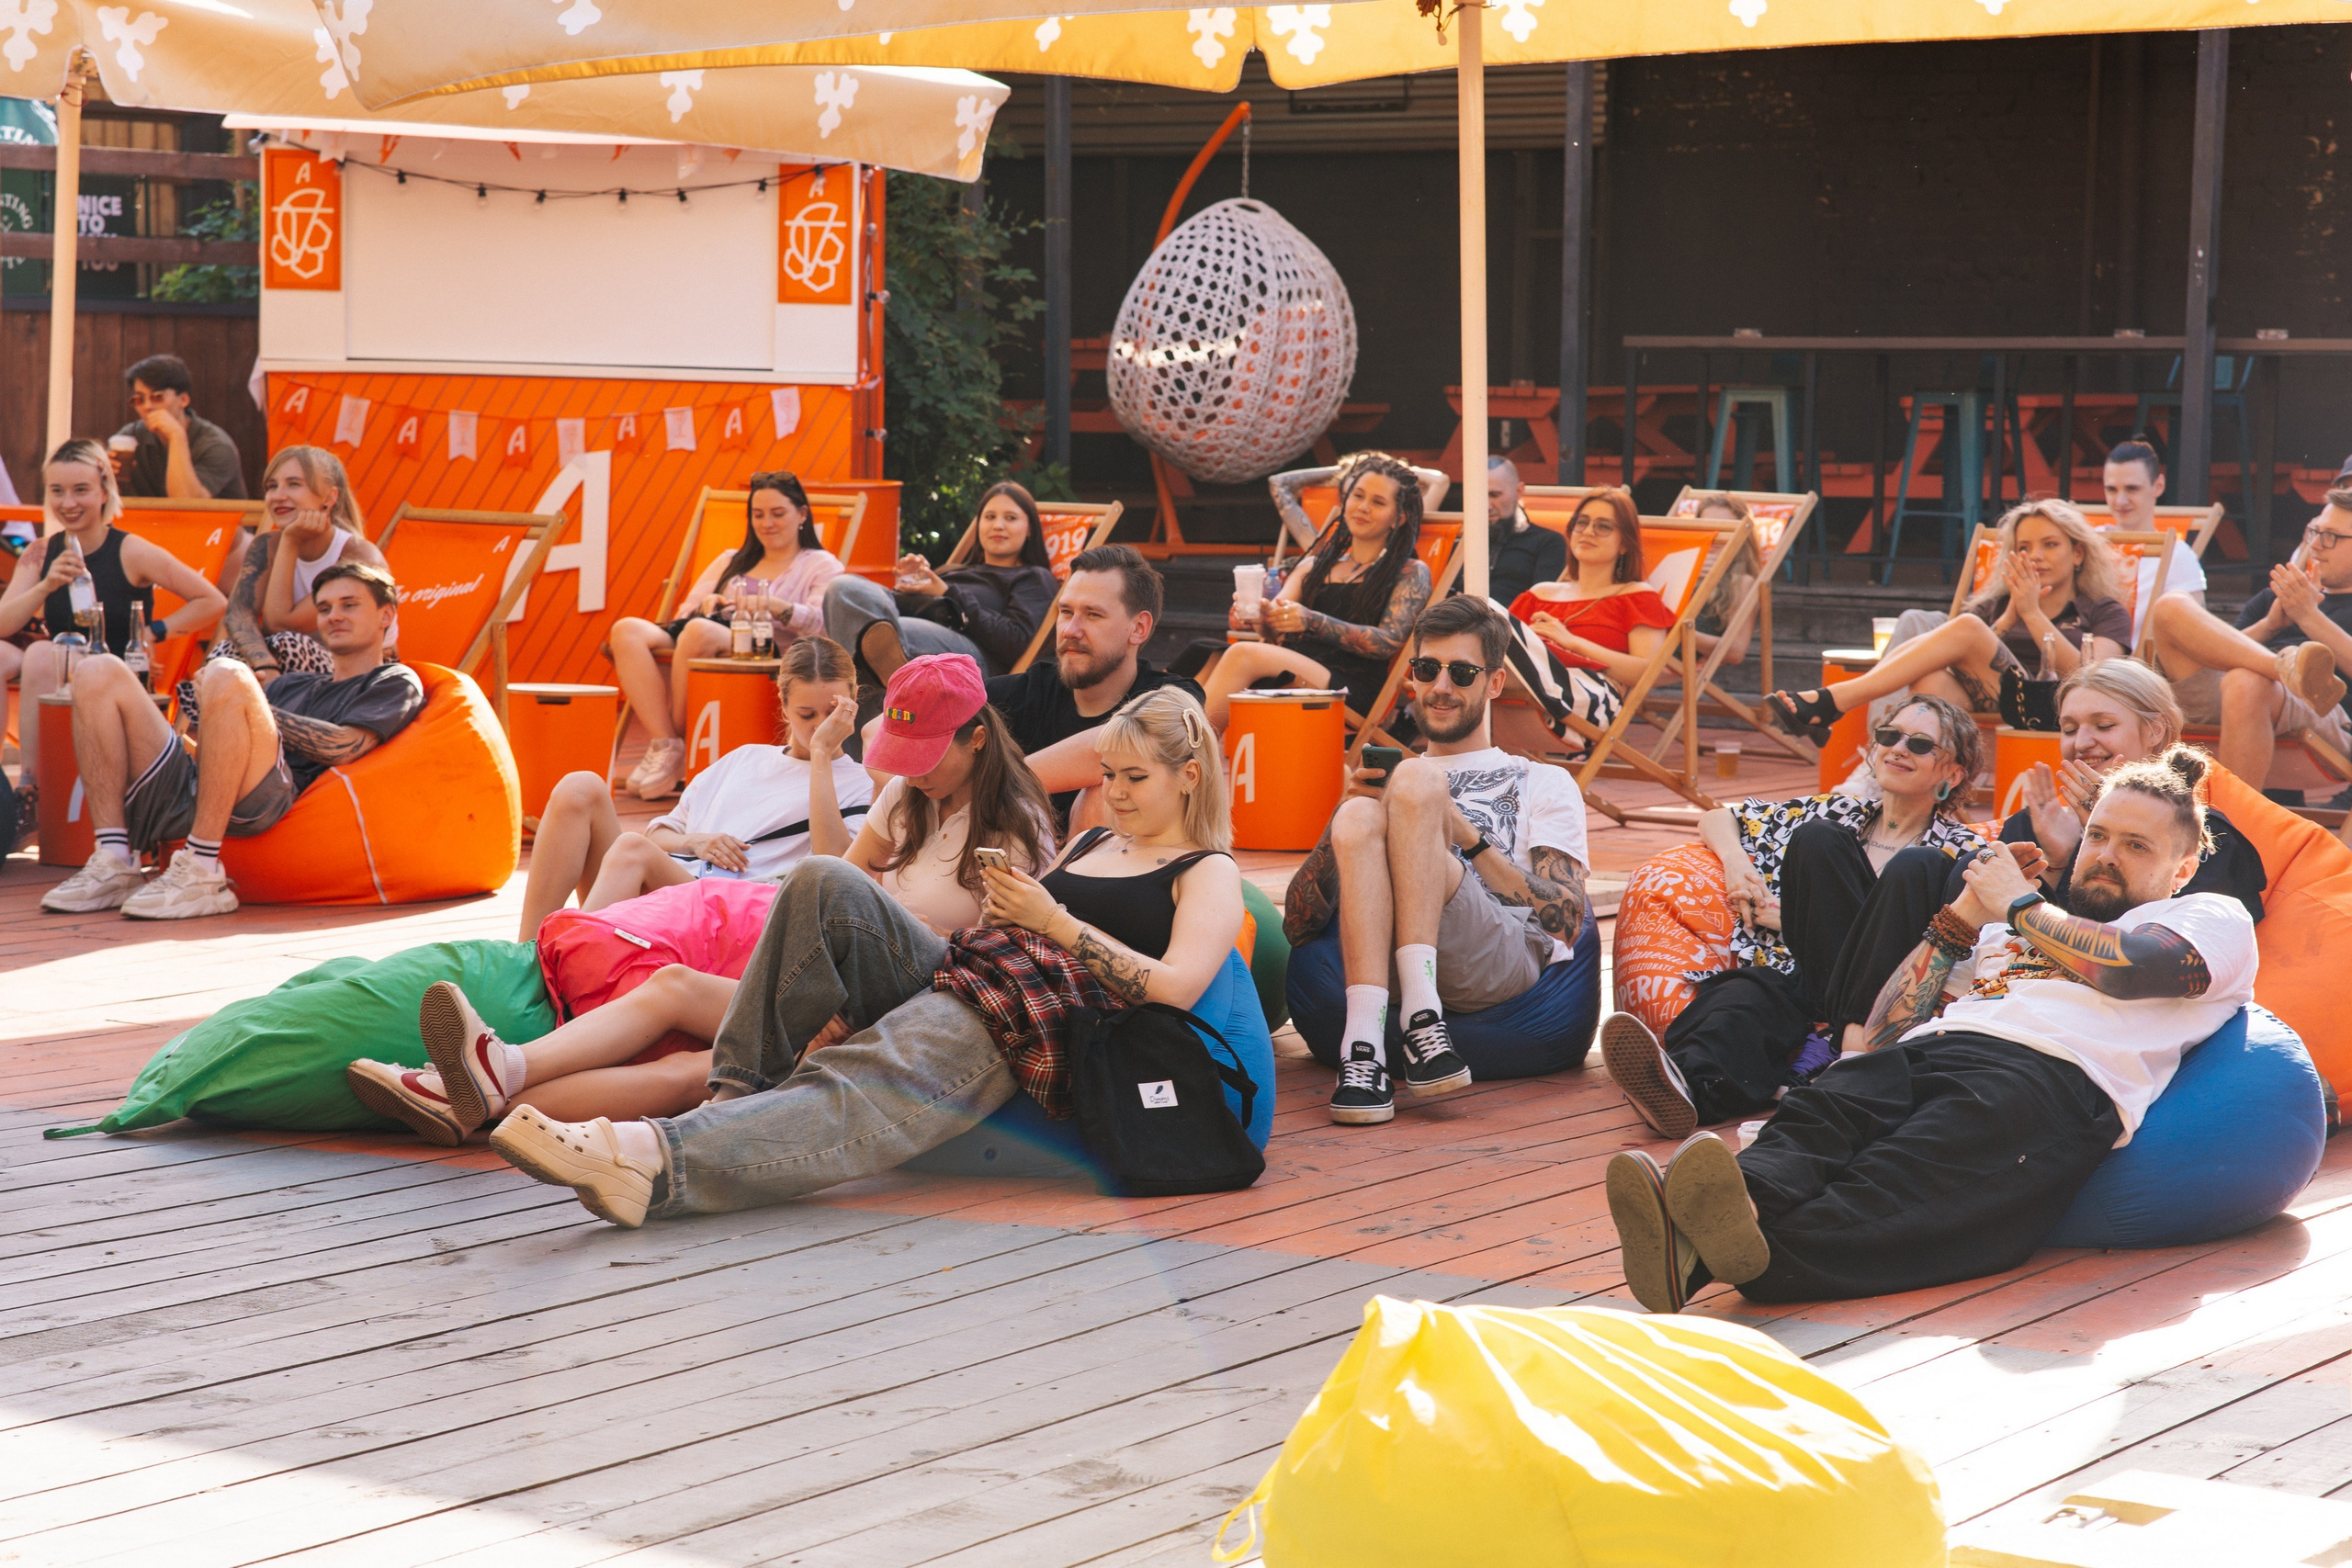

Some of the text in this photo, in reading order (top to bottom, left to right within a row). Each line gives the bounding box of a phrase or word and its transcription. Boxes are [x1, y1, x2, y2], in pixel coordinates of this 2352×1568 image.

[295, 162, 311, 185] A
[77, 195, 122, 217] NICE
[78, 214, 105, 233] TO
[284, 387, 310, 413] A
[397, 416, 418, 445] A
[617, 415, 637, 441] A
[725, 407, 742, 439] A
[507, 424, 526, 457] A
[205, 527, 223, 547] A
[492, 535, 512, 554] A
[499, 449, 612, 622] A
[411, 573, 485, 610] original
[689, 700, 720, 770] A
[1230, 732, 1255, 808] A
[1625, 922, 1692, 943] ORIGINALE
[1355, 1045, 1372, 1054] VANS
